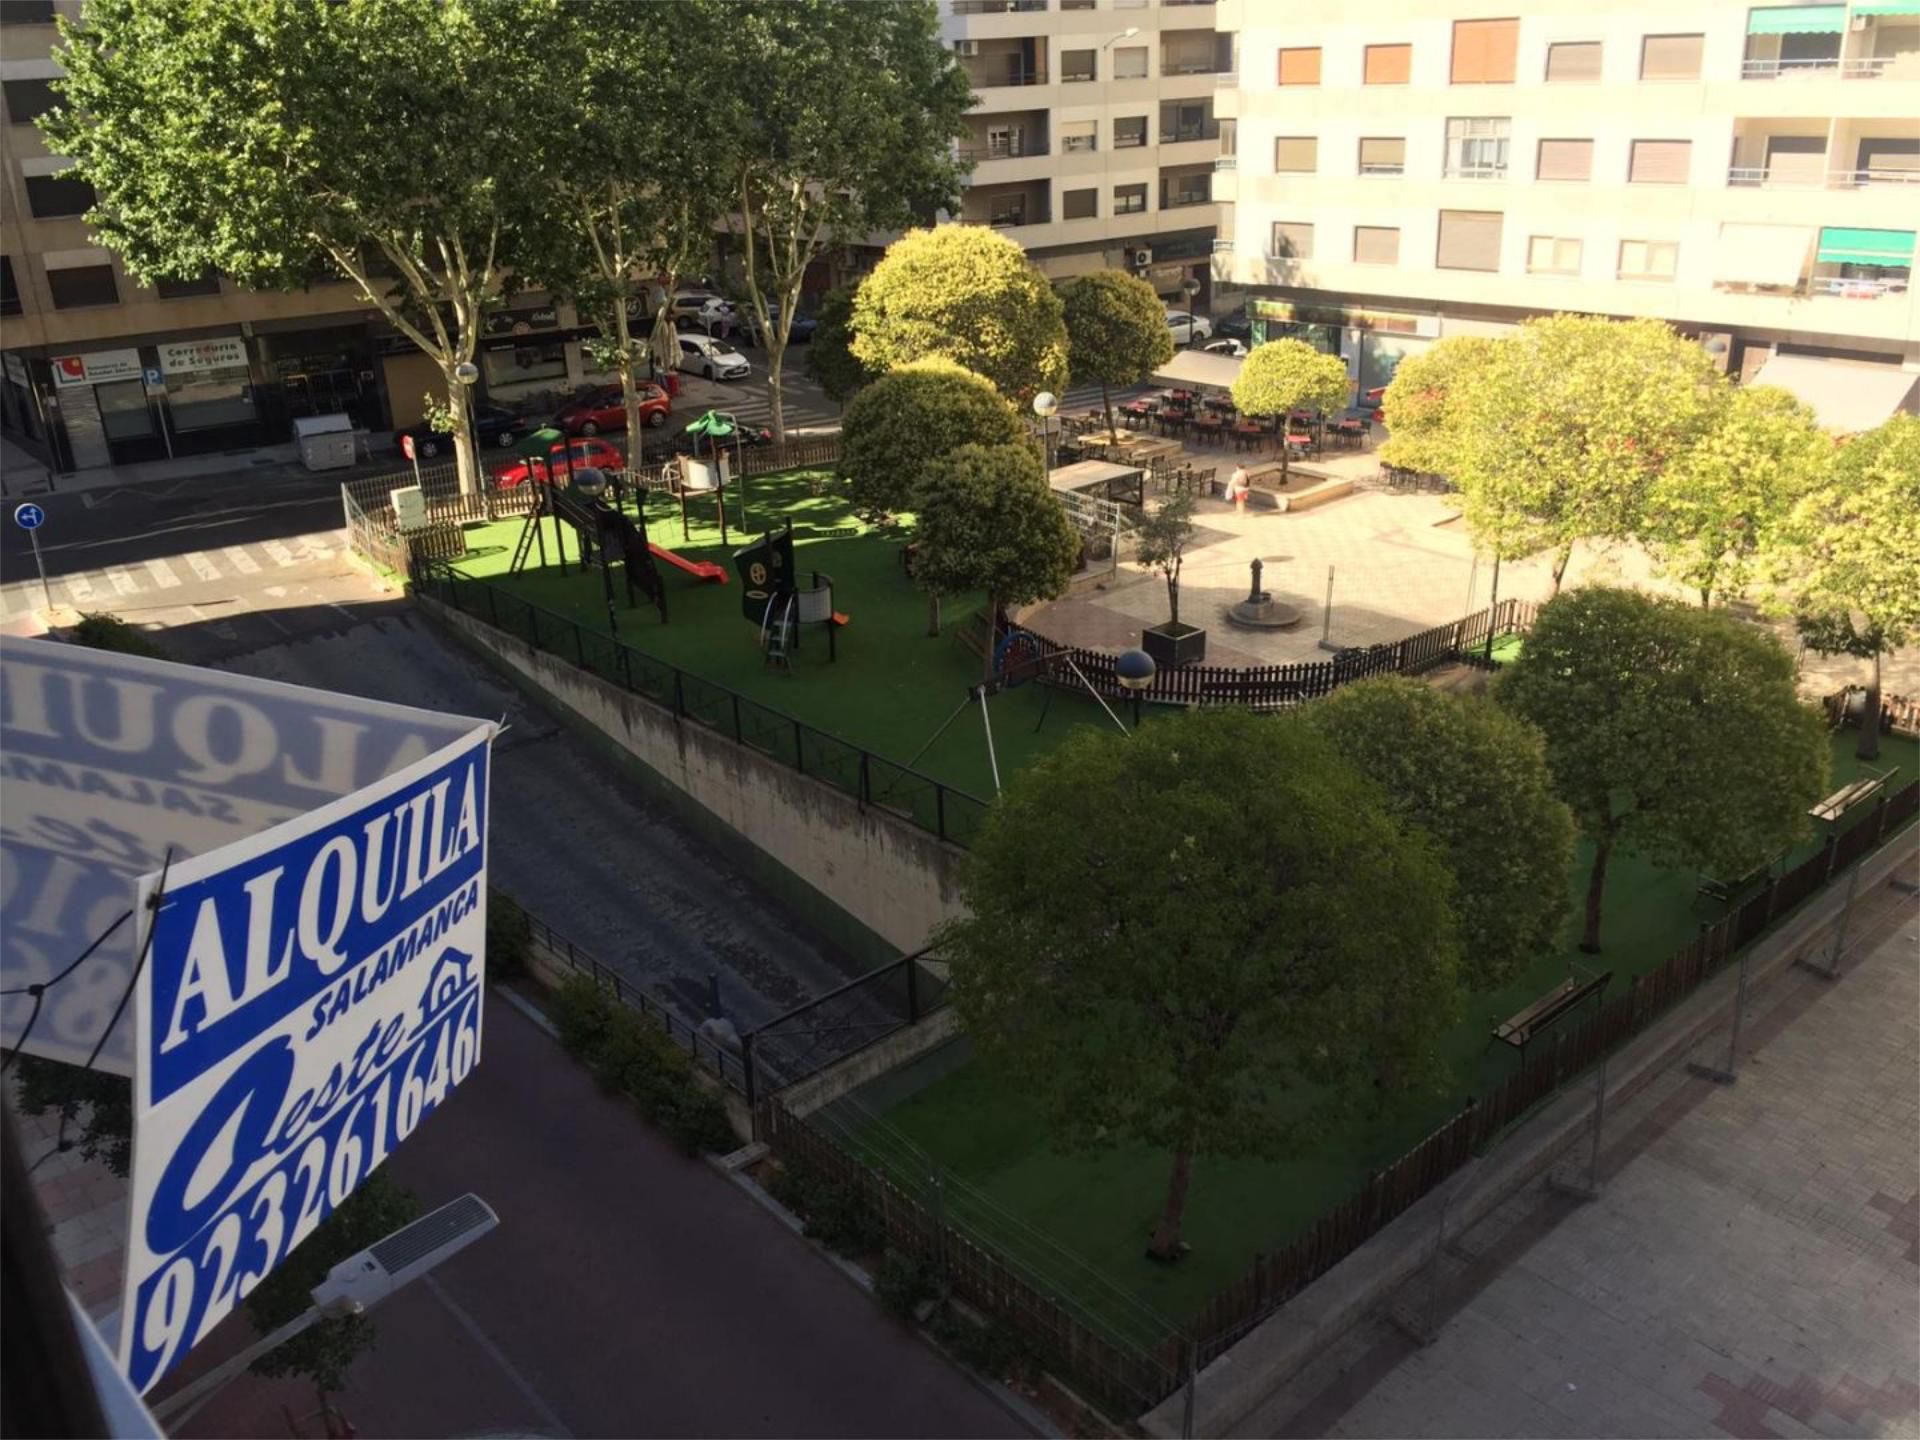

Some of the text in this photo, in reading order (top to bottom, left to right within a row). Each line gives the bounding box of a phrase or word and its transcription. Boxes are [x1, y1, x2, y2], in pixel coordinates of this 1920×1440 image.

[146, 370, 159, 384] P
[169, 352, 240, 368] de Seguros
[160, 762, 480, 1056] ALQUILA
[305, 879, 478, 1042] SALAMANCA
[138, 991, 476, 1398] 923261646
[146, 1012, 406, 1255] Oeste
